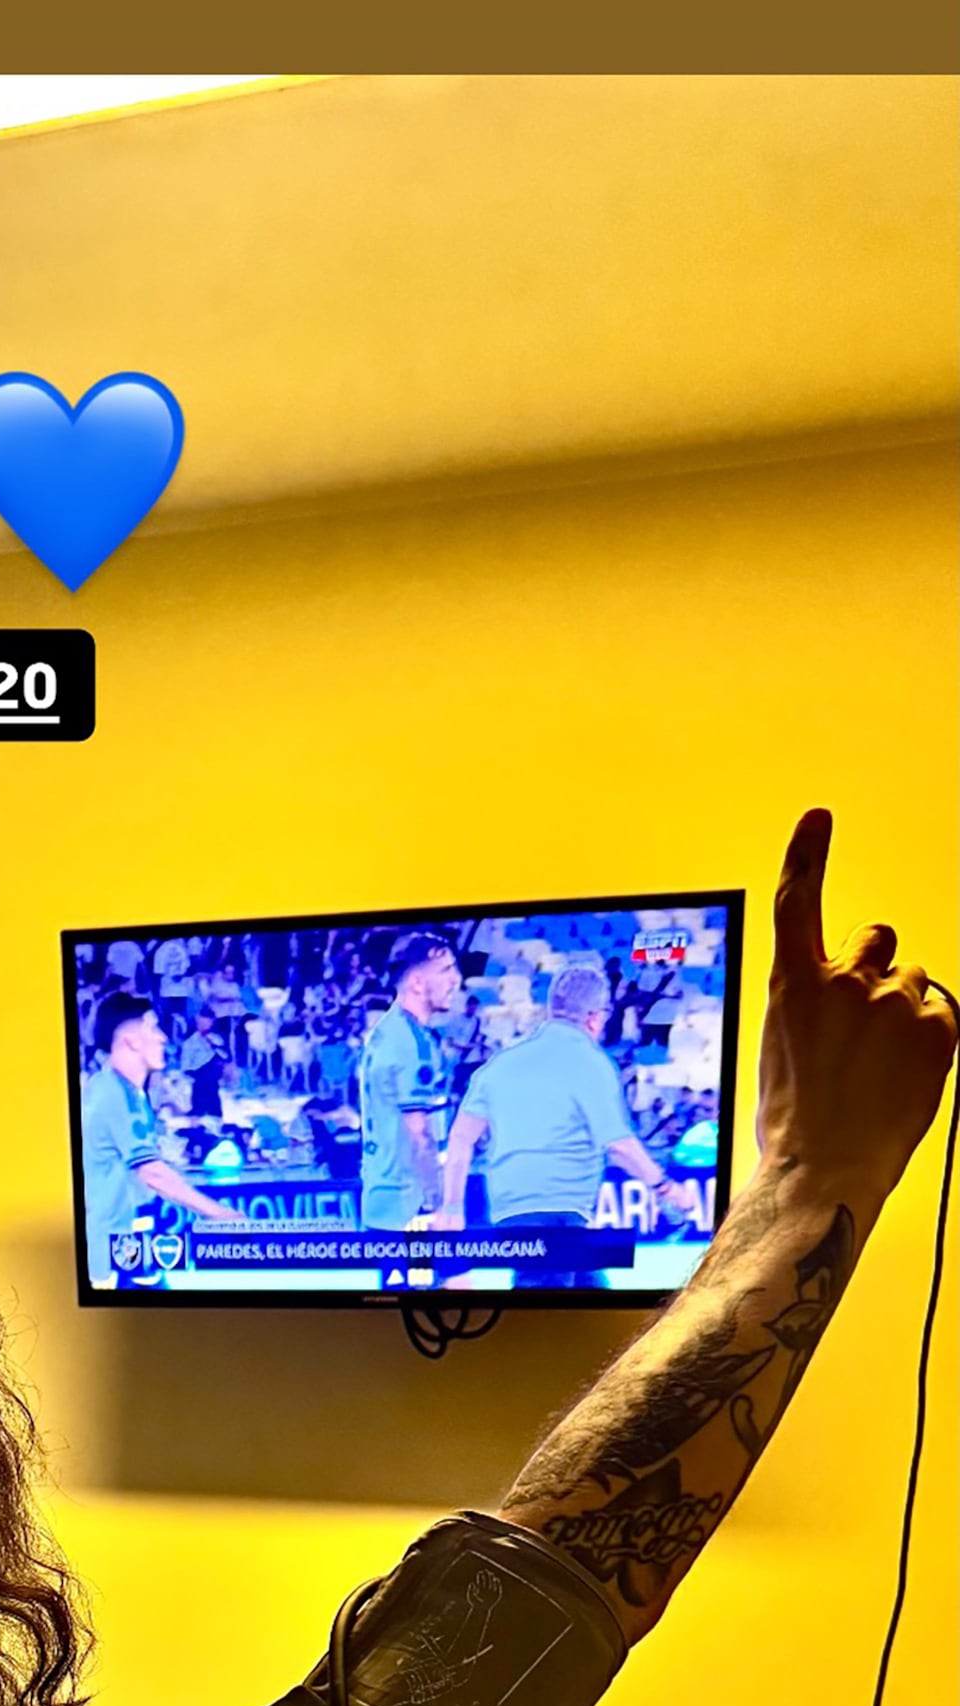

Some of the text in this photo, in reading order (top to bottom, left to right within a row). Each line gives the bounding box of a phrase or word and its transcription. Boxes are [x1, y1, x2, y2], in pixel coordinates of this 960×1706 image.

[196, 1242, 265, 1260] PAREDES,
[267, 1242, 284, 1259] EL
[340, 1241, 361, 1259] DE
[364, 1241, 408, 1258] BOCA
[410, 1241, 433, 1258] EN
[434, 1241, 454, 1258] EL
